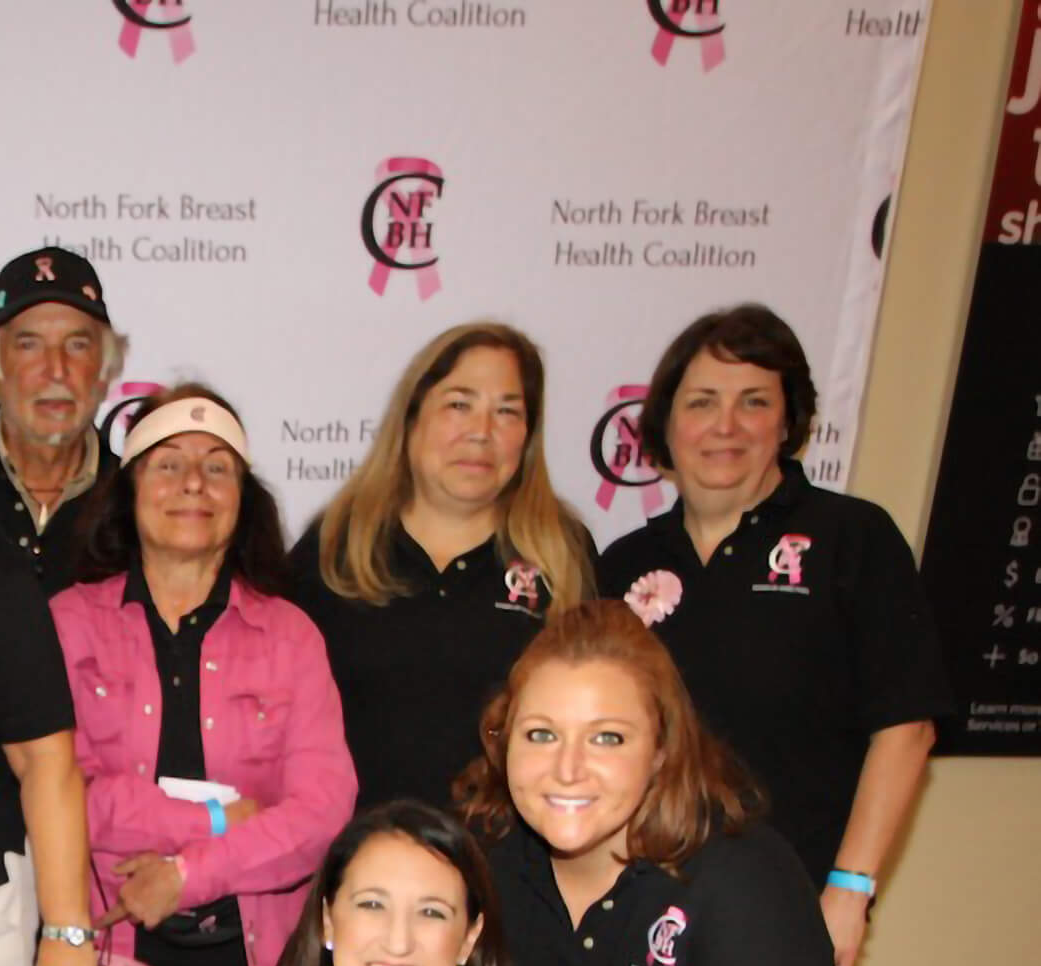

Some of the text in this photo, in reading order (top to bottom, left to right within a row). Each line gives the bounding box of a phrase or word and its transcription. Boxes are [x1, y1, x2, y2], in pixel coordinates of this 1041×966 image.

[314, 0, 526, 28] Health Coalition
[35, 194, 257, 222] North Fork Breast
[551, 199, 770, 227] North Fork Breast
[132, 236, 247, 263] Coalition
[554, 241, 757, 268] Health Coalition
[280, 419, 350, 442] North
